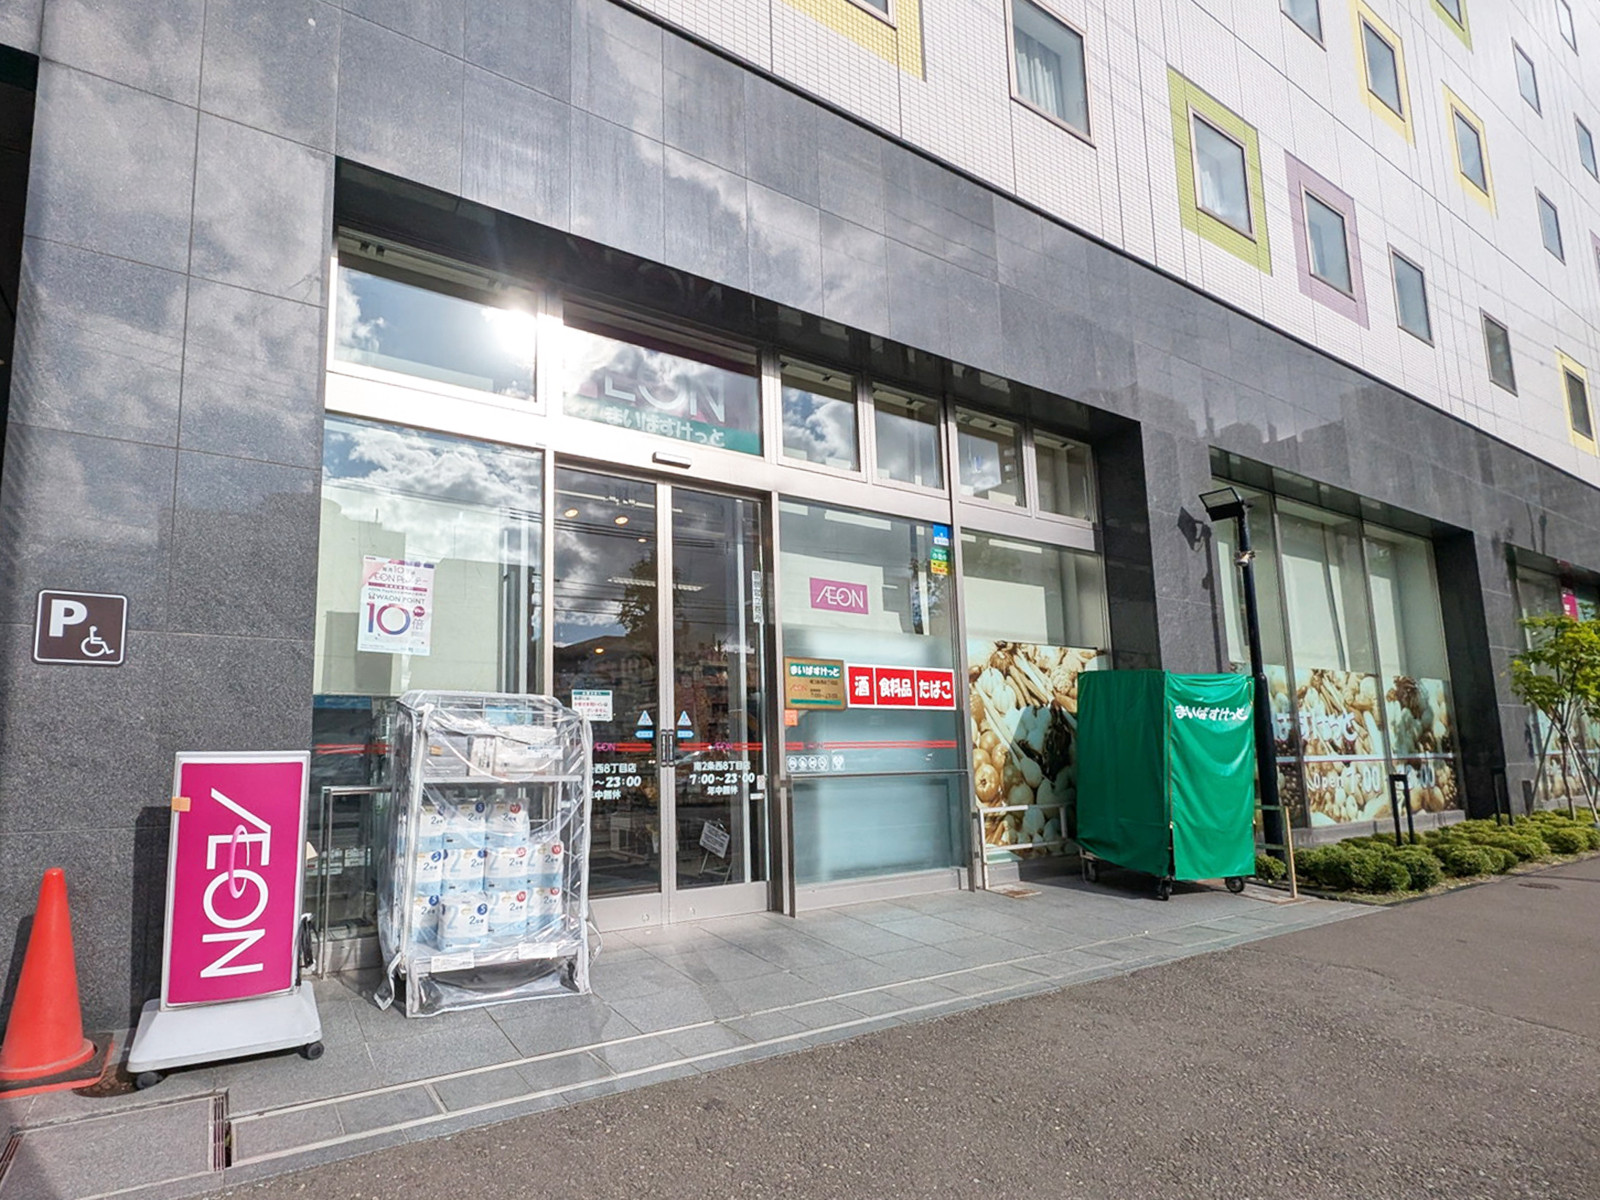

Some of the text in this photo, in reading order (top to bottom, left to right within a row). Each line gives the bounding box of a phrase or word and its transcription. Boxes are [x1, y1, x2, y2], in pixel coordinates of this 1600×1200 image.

[48, 599, 88, 637] P
[854, 675, 952, 699] 酒 食料品 たばこ
[1174, 704, 1249, 721] まいばすけっと
[592, 763, 636, 774] 西8丁目店
